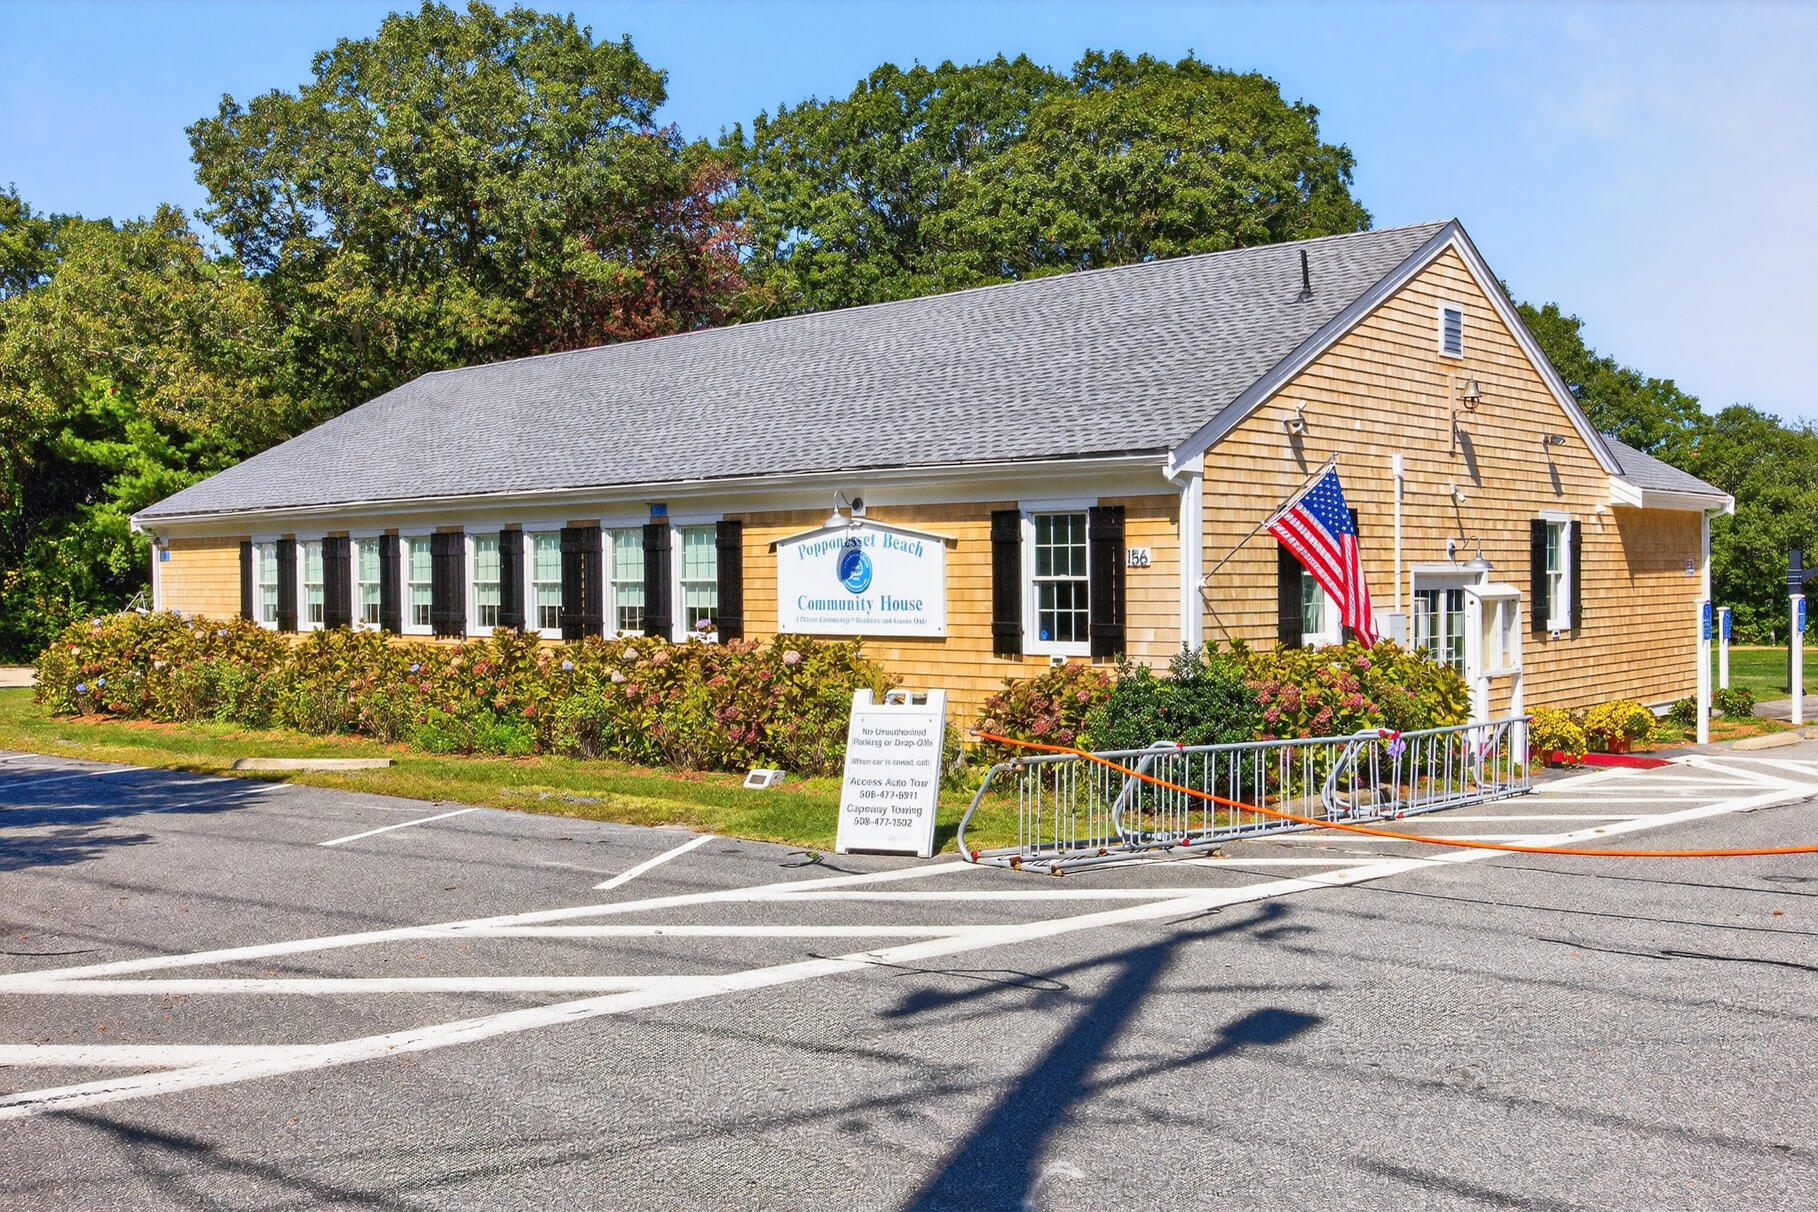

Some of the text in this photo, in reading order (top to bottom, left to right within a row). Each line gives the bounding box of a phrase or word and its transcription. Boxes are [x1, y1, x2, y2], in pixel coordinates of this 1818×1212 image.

[883, 532, 924, 558] Beach
[1127, 549, 1149, 566] 156
[797, 594, 923, 615] Community House
[862, 728, 927, 737] No Unauthorized
[853, 737, 882, 748] Parking
[884, 739, 892, 747] or
[852, 757, 872, 766] When
[872, 758, 883, 766] car
[884, 758, 891, 766] is
[849, 776, 928, 788] Access Auto Tow
[846, 803, 923, 818] Capeway Towing
